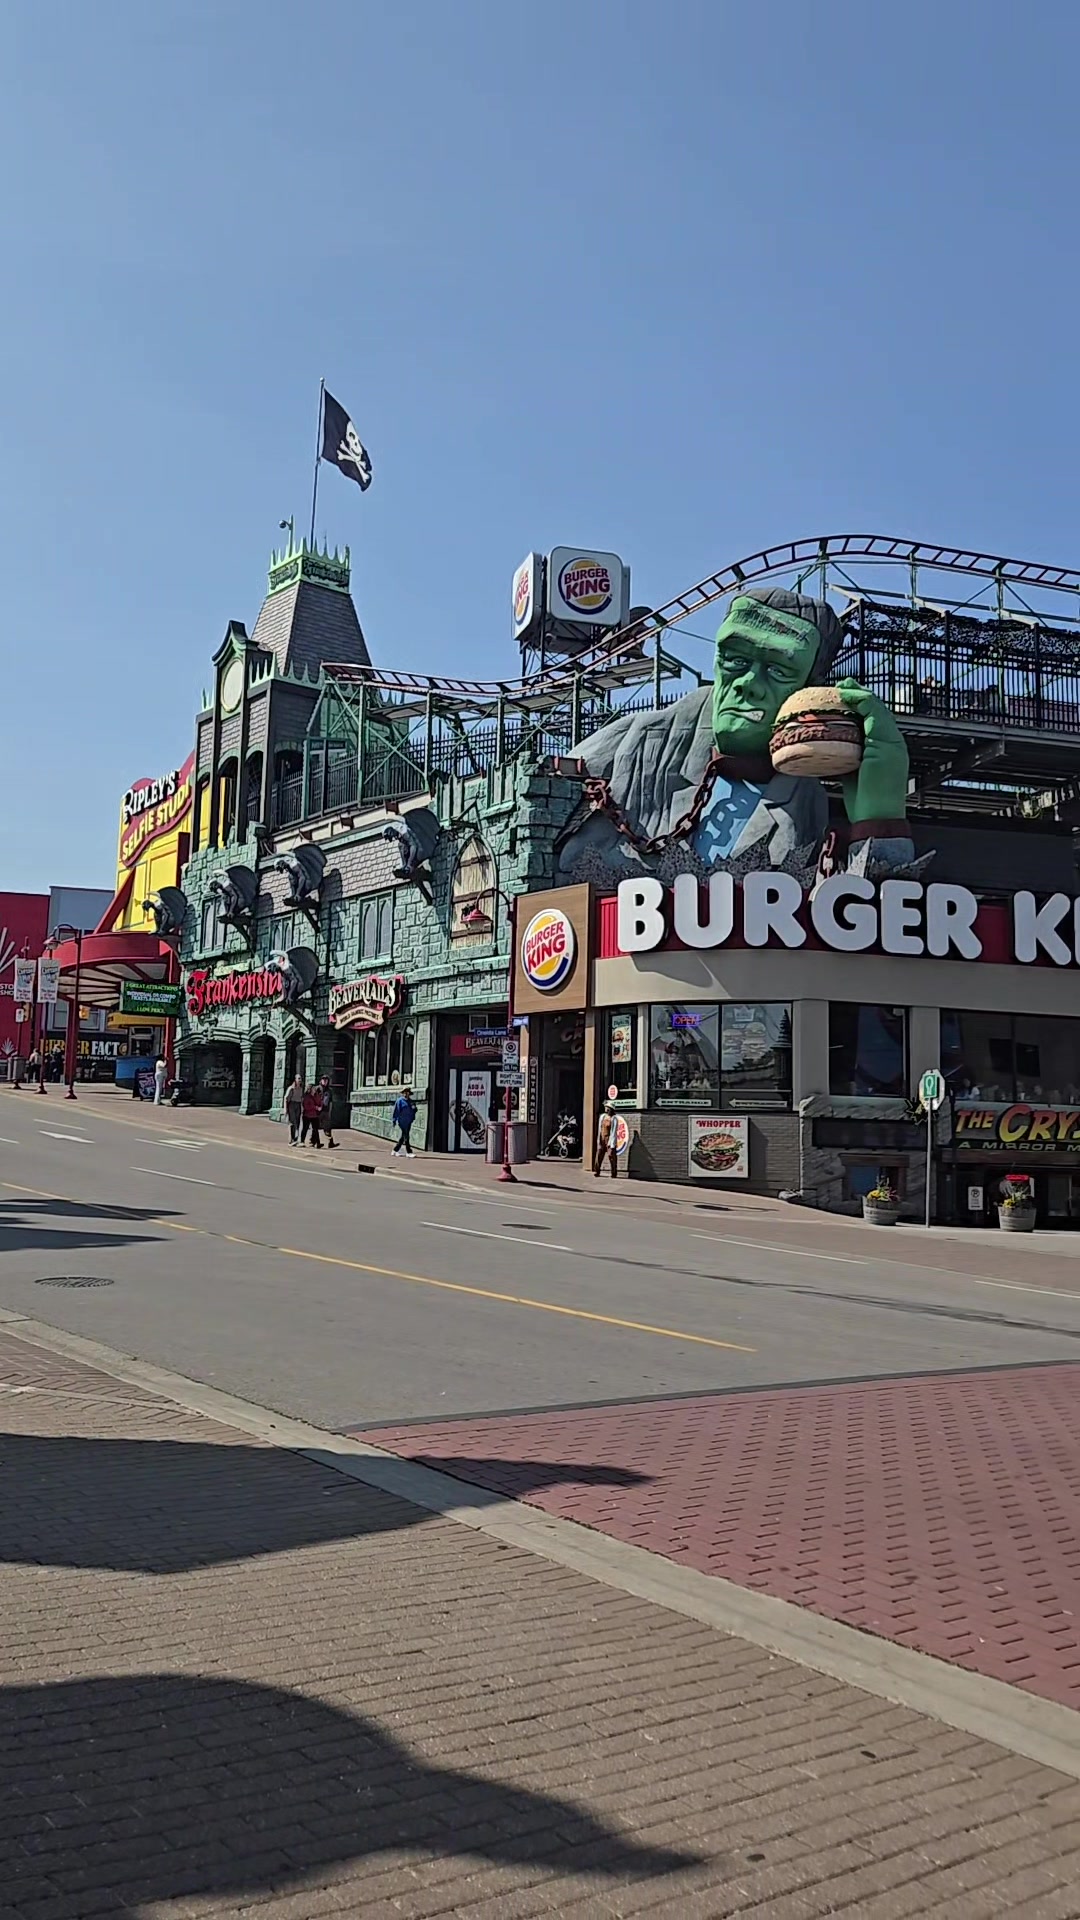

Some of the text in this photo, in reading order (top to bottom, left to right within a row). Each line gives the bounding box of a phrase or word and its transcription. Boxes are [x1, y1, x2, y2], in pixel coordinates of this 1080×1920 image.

[564, 568, 609, 585] BURGER
[565, 578, 610, 600] KING
[123, 771, 177, 824] RIPLEY'S
[122, 775, 190, 861] SELFIE STUDI
[617, 871, 1080, 966] BURGER K
[526, 921, 564, 955] BURGER
[527, 934, 565, 974] KING
[187, 968, 282, 1015] Frankenstei
[675, 1016, 697, 1024] OPEN
[202, 1080, 236, 1088] TICKETS
[696, 1120, 741, 1128] WHOPPER
[956, 1109, 994, 1132] THE
[982, 1142, 1056, 1151] MIRROR
